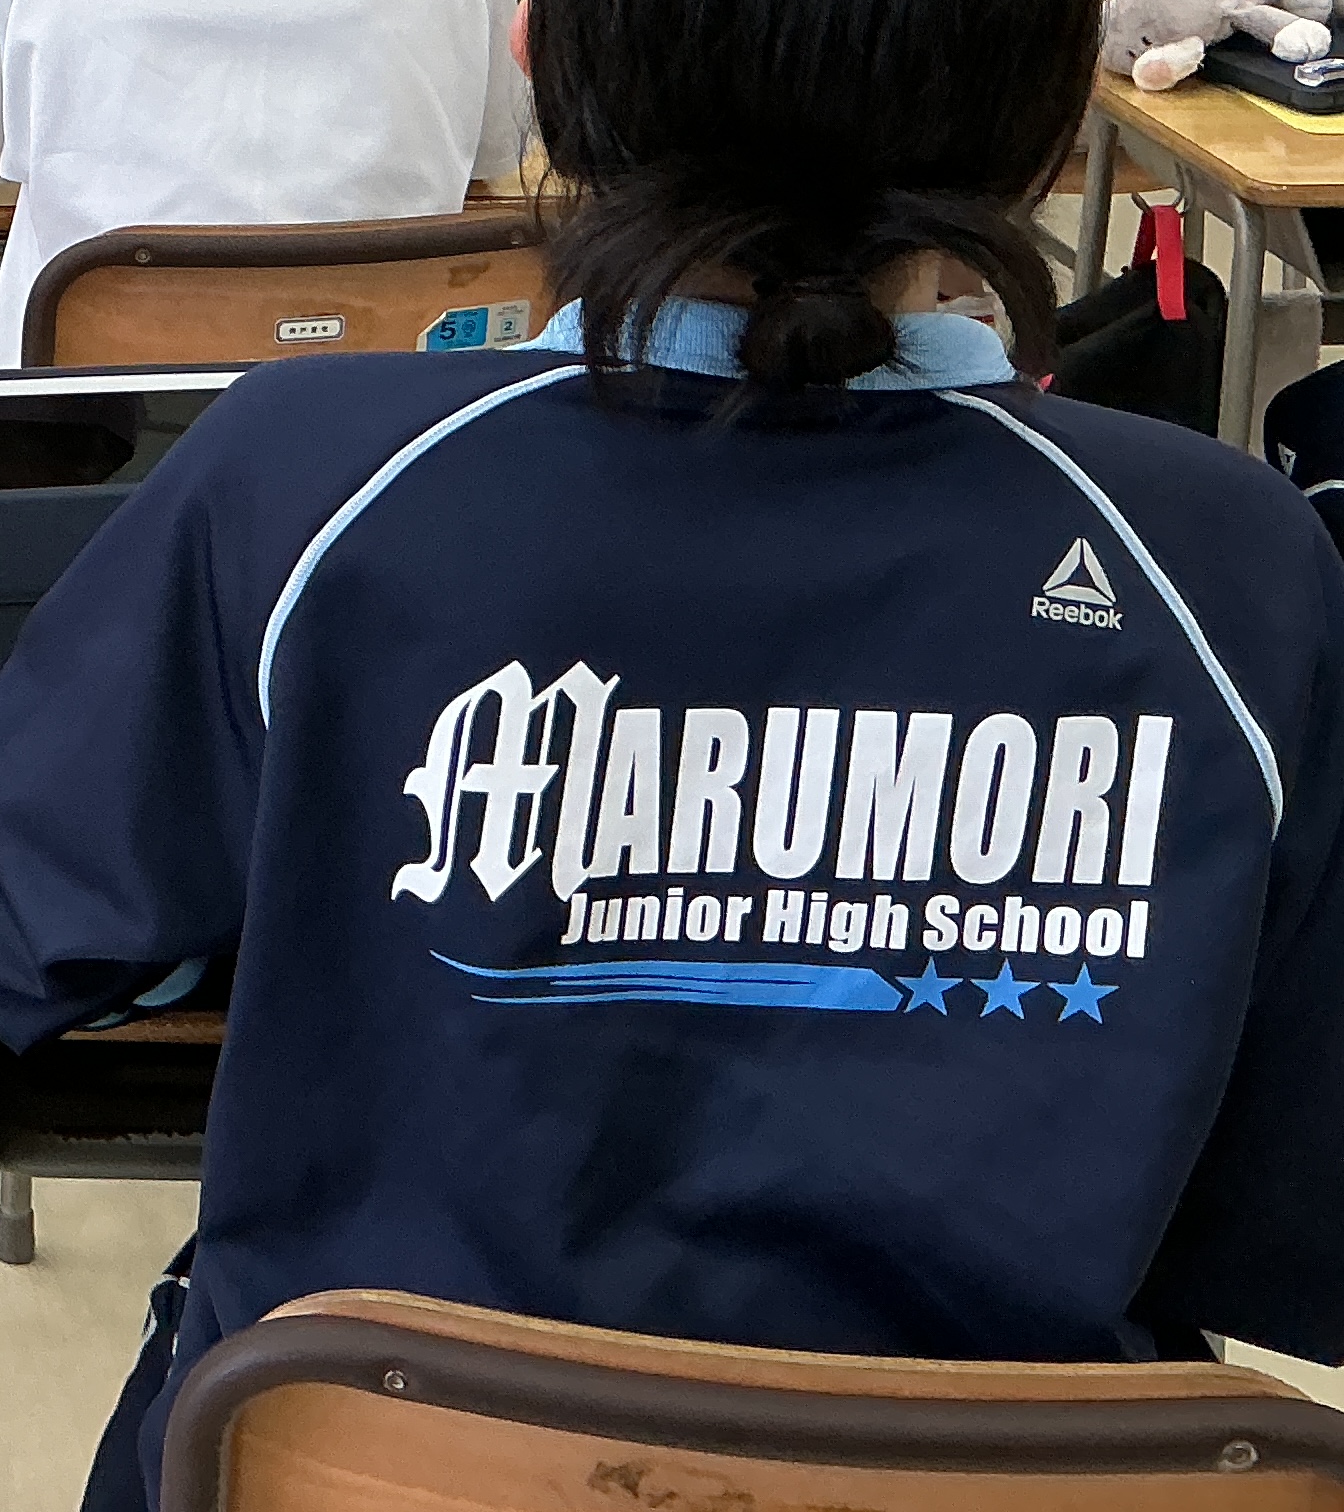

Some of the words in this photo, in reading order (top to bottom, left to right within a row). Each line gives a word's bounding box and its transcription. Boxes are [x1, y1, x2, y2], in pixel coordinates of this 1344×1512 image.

[1031, 596, 1123, 631] Reebok
[391, 659, 1175, 903] MARUMORI
[560, 886, 752, 946] Junior
[764, 889, 910, 951] High
[921, 899, 1149, 959] School
